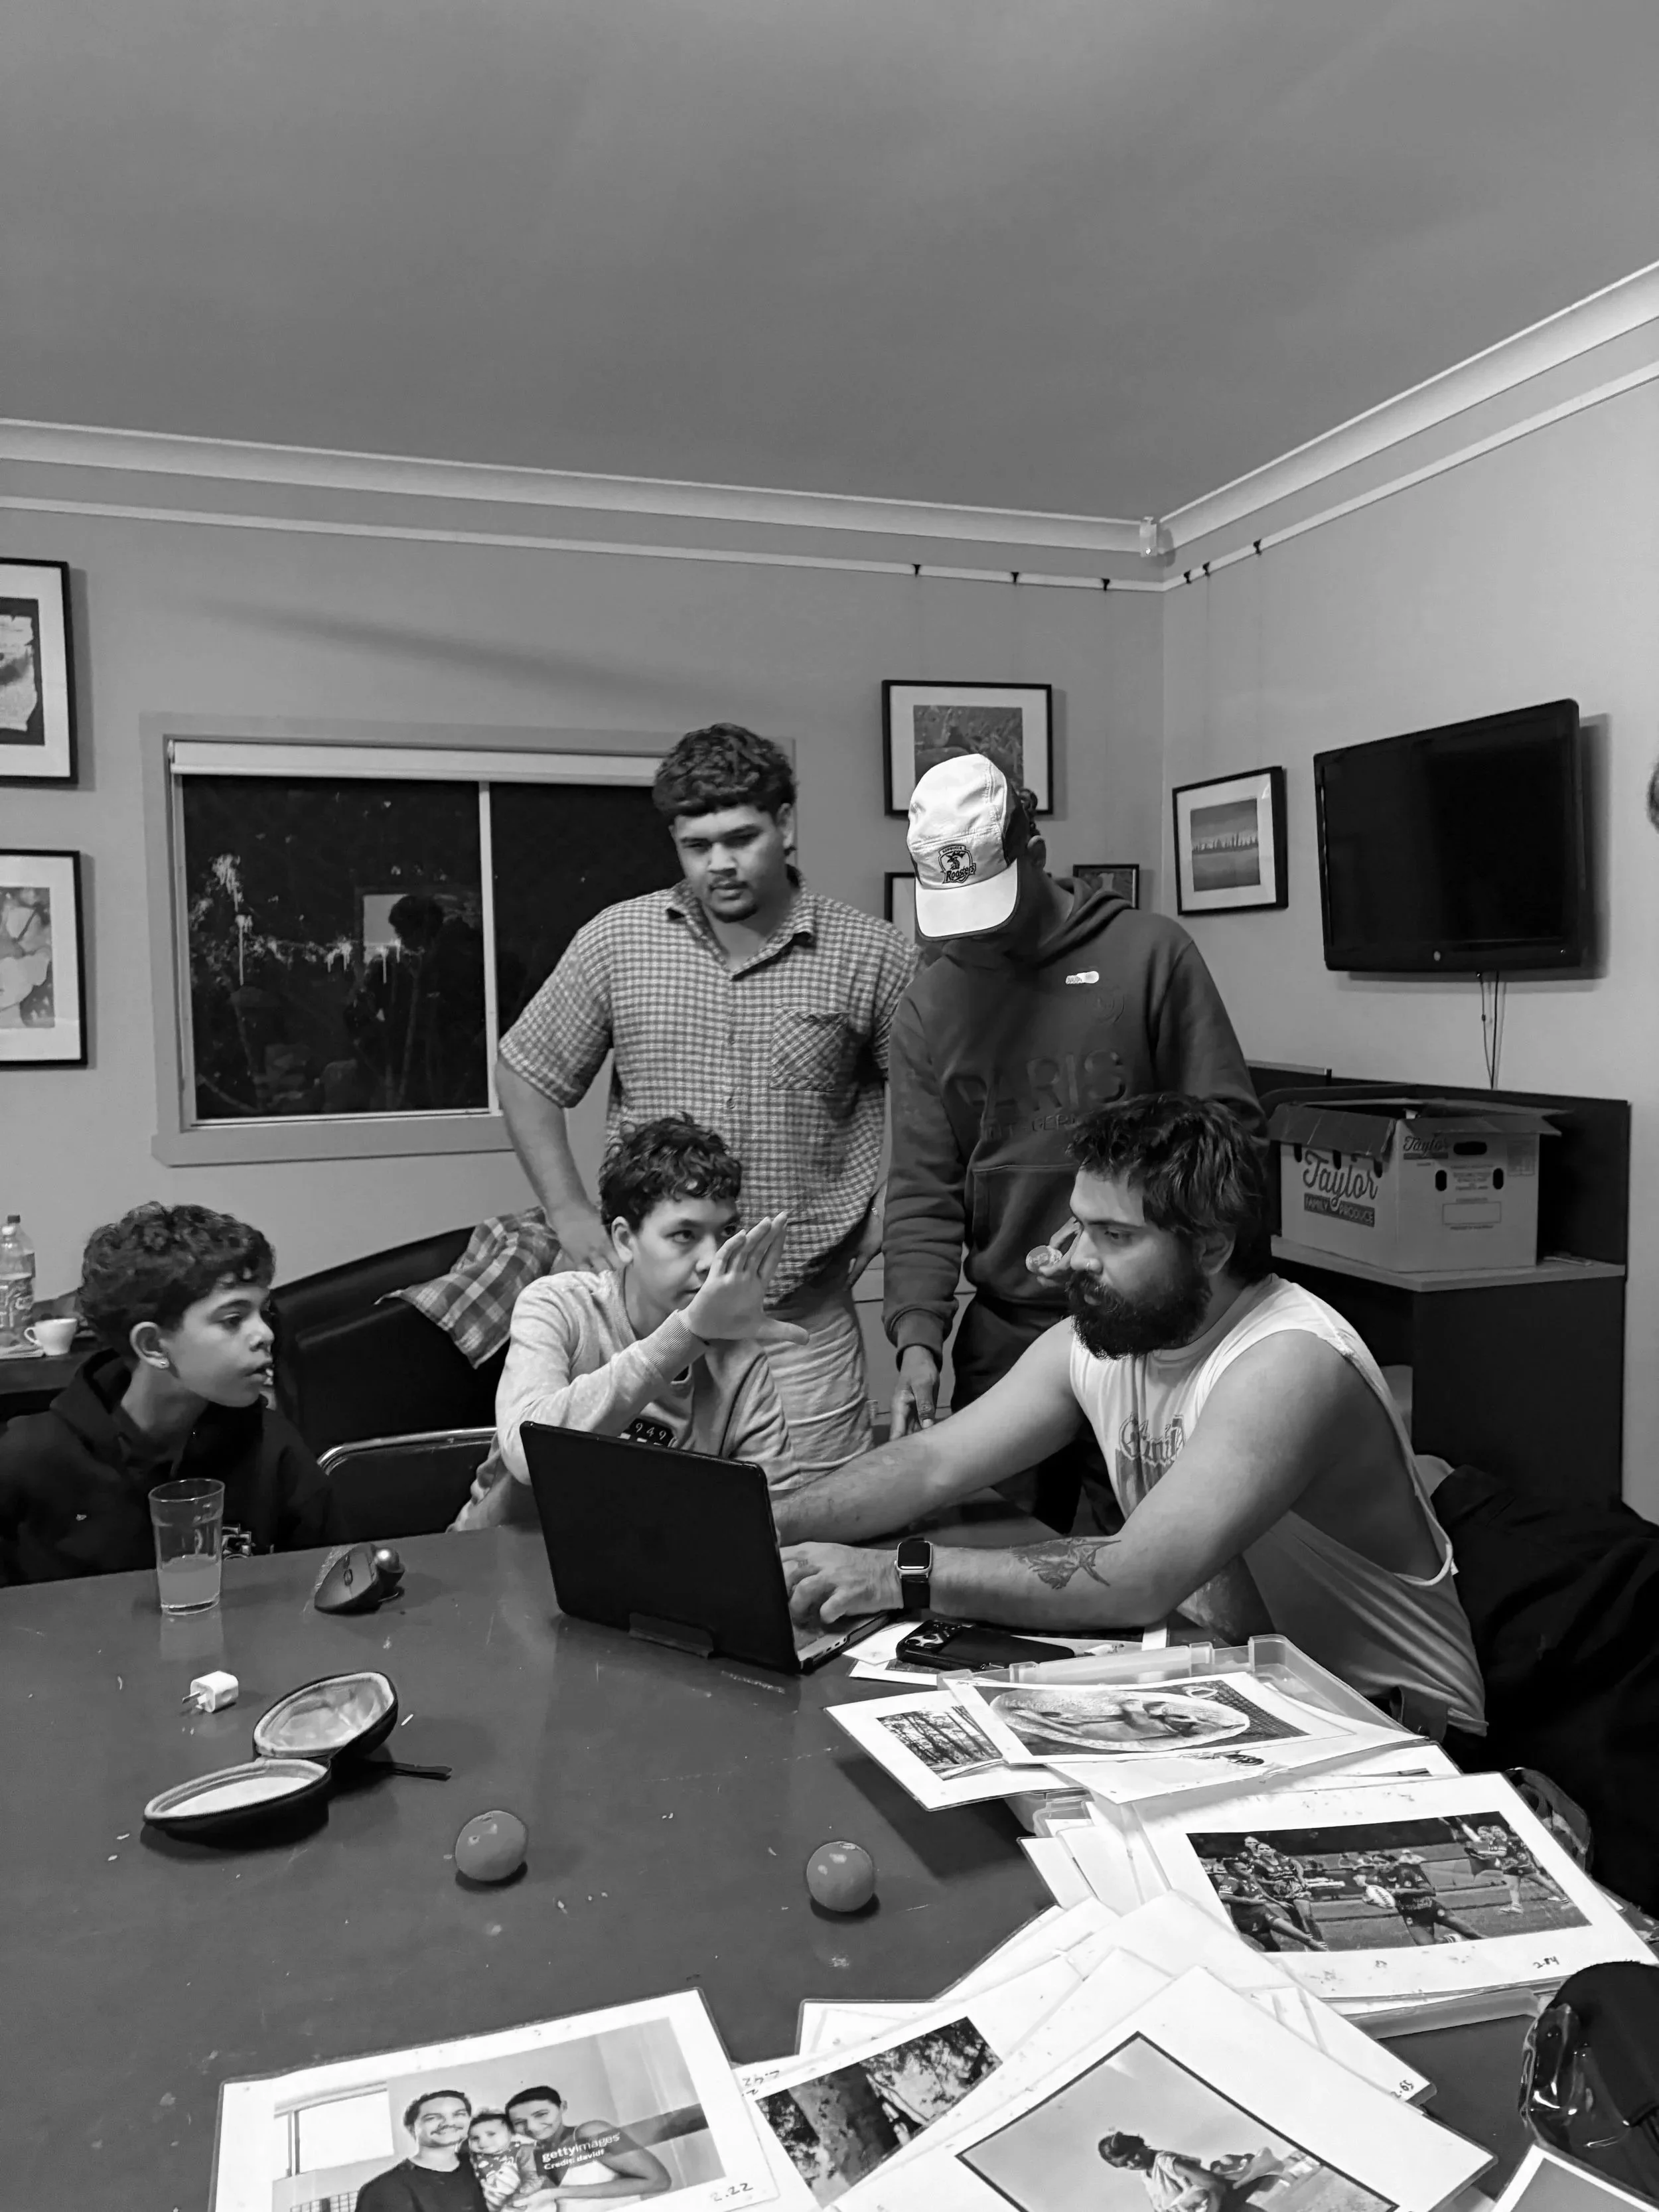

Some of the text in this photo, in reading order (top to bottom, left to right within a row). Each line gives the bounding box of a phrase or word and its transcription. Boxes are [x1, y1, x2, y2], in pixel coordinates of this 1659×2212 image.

[1303, 1149, 1378, 1207] Taylor
[1338, 1203, 1374, 1223] PRODUCE
[541, 2132, 620, 2163] gettyimages
[710, 2182, 754, 2202] 2.22
